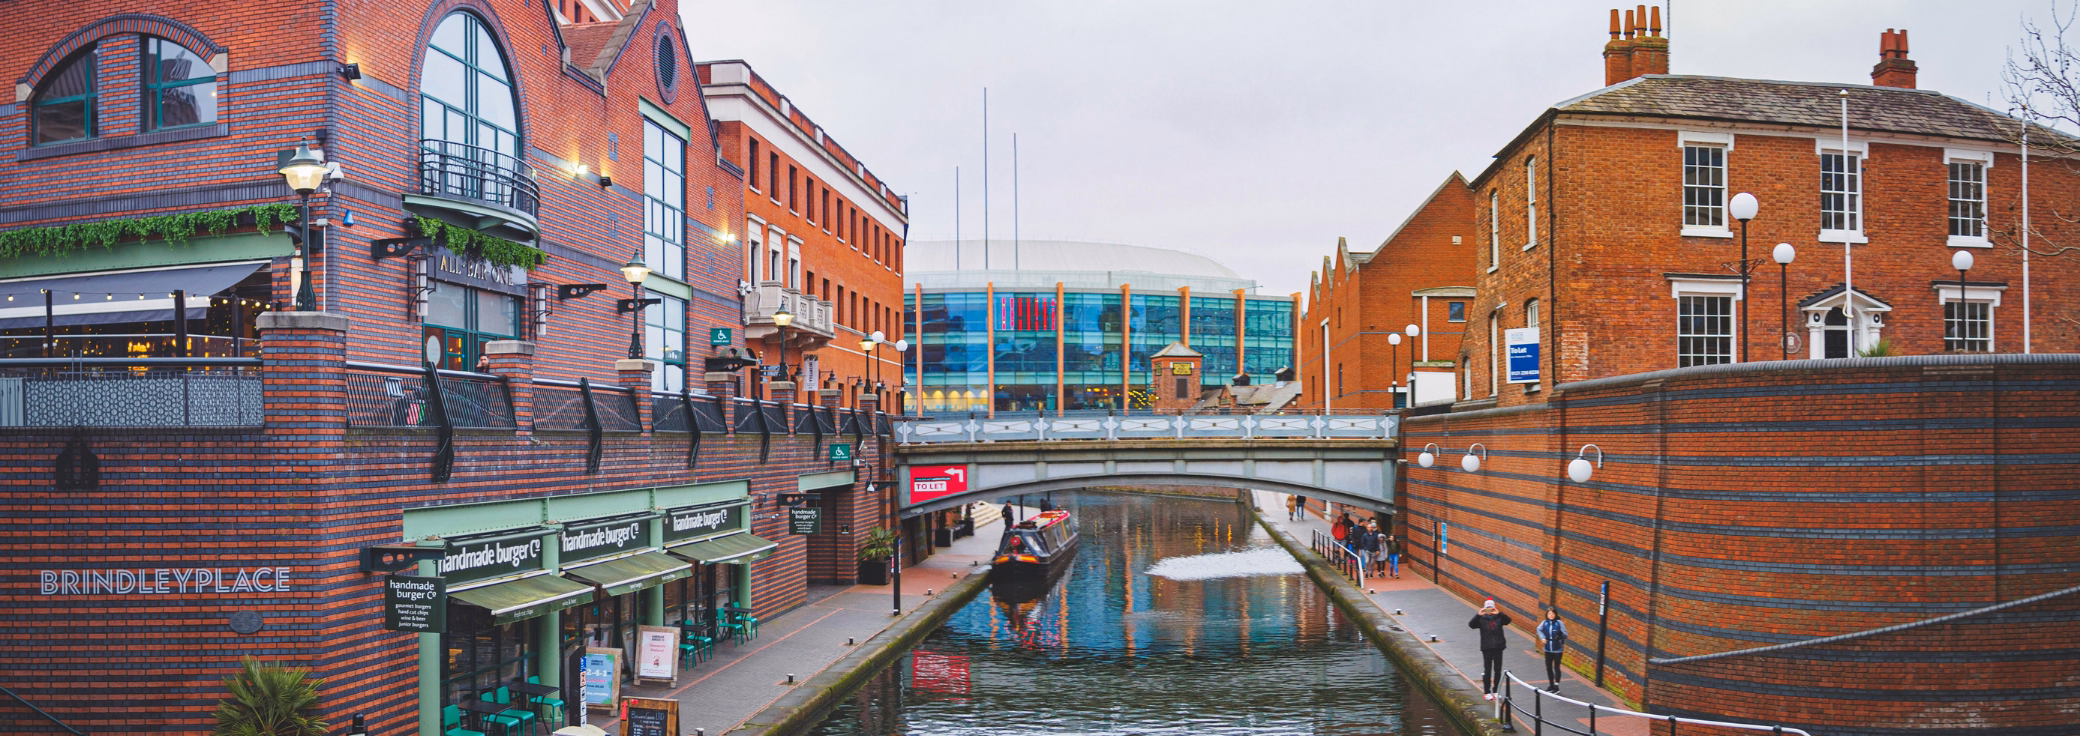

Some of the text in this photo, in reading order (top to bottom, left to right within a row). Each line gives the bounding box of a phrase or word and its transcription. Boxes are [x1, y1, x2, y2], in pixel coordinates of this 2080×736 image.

[440, 255, 461, 274] ALL
[673, 513, 703, 531] handmade
[703, 511, 720, 529] burger
[562, 528, 605, 552] handmade
[605, 527, 631, 547] burger
[439, 544, 494, 573] handmade
[496, 542, 529, 567] burger
[40, 567, 290, 595] BRINDLEYPLACE
[390, 580, 434, 590] handmade
[396, 589, 425, 601] burger
